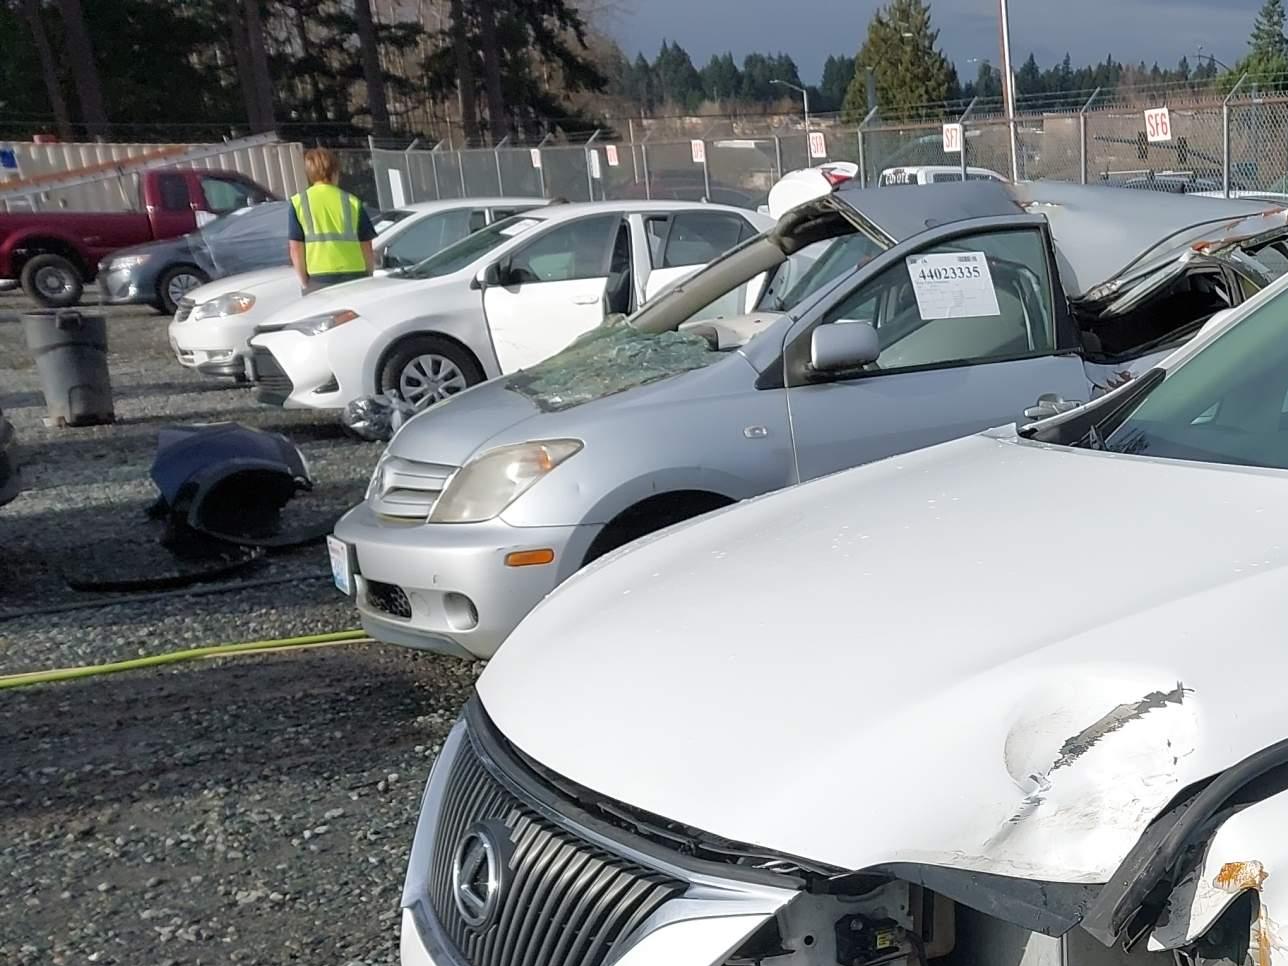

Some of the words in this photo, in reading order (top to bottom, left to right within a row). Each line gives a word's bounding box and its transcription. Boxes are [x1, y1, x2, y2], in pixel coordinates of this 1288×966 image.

[1146, 112, 1170, 138] SF6
[945, 127, 958, 148] SF7
[919, 266, 981, 281] 44023335
